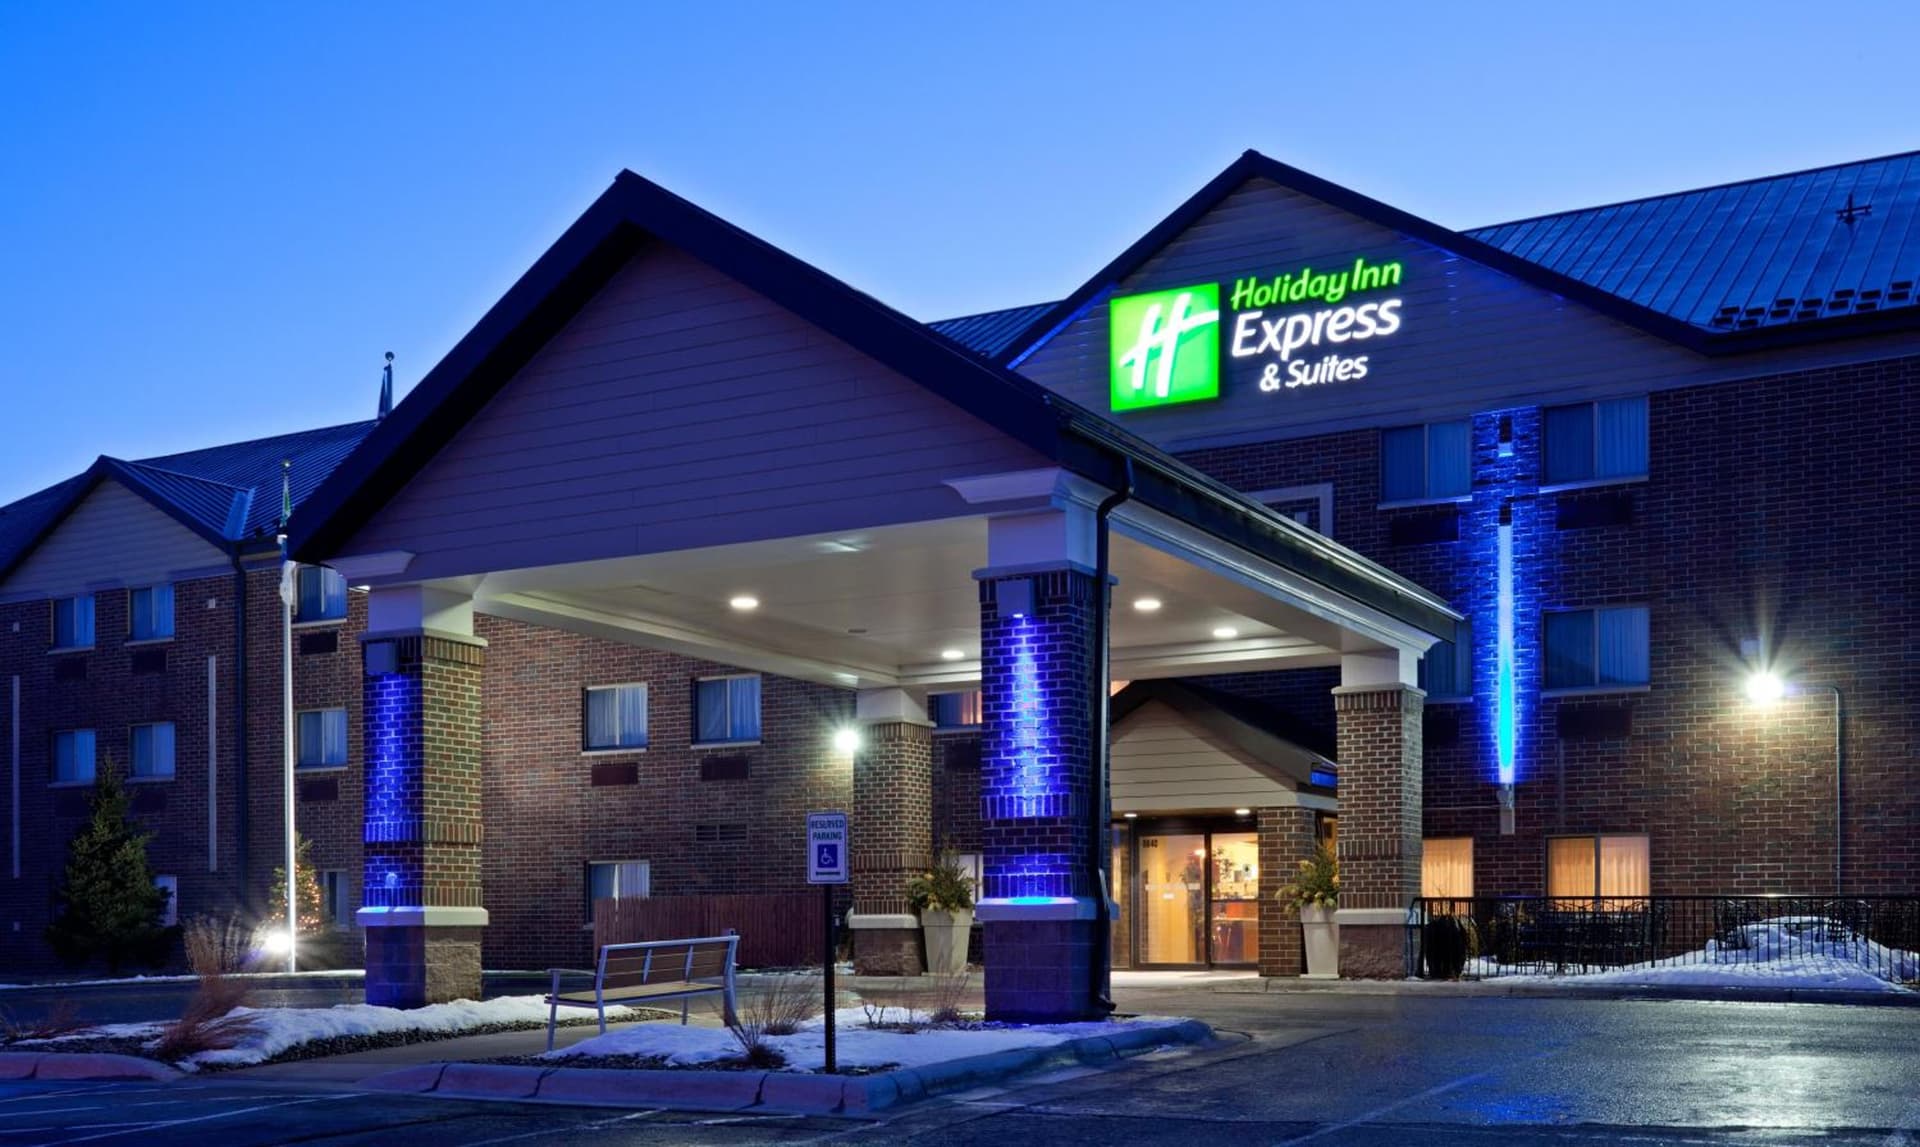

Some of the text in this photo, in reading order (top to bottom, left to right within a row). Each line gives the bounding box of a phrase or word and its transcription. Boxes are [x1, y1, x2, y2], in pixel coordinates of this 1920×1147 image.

[1231, 258, 1401, 309] Holiday Inn
[1231, 299, 1402, 360] Express
[1259, 355, 1368, 392] & Suites
[811, 820, 845, 829] RESERVED
[812, 831, 843, 840] PARKING
